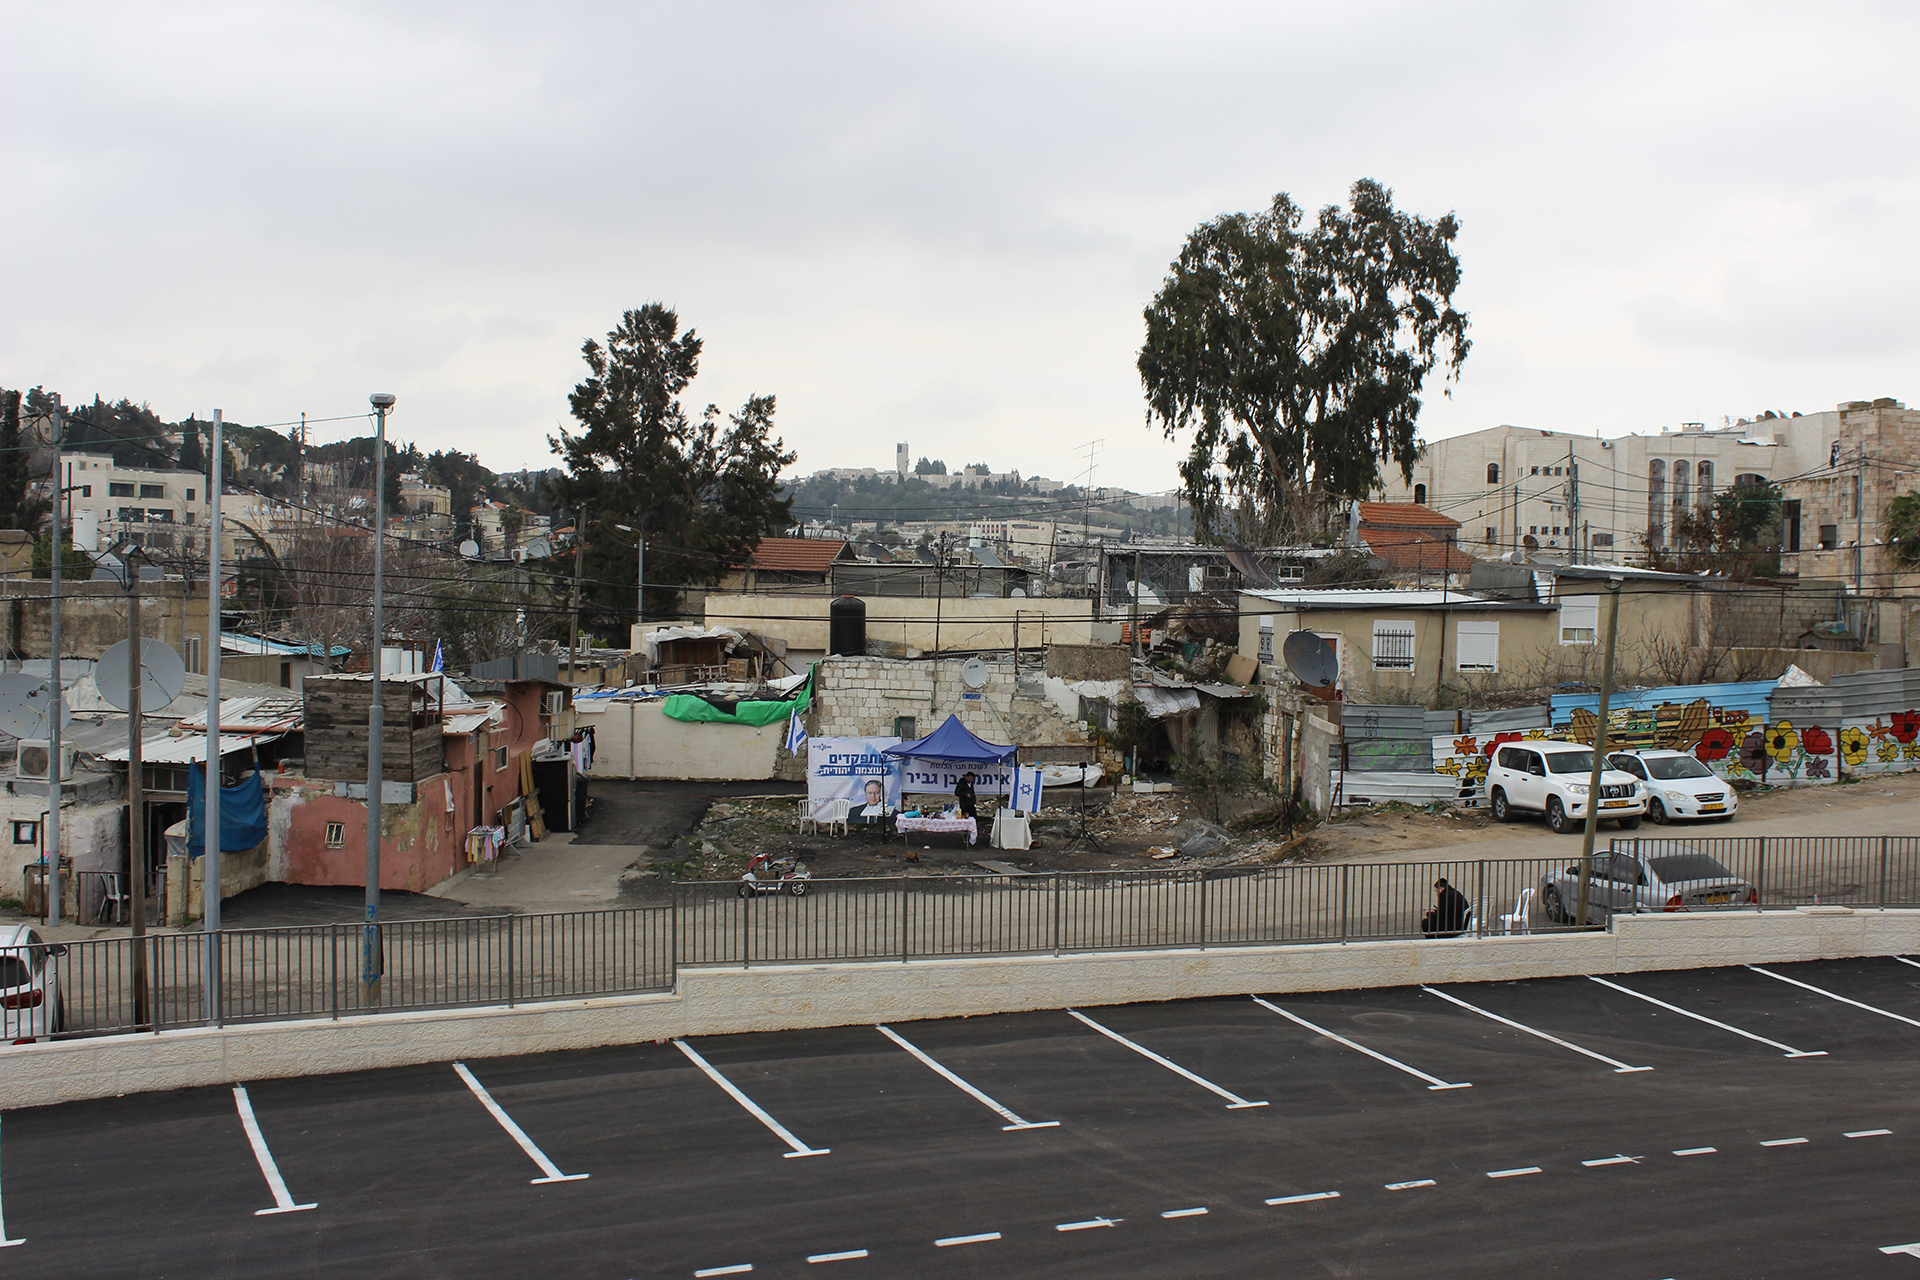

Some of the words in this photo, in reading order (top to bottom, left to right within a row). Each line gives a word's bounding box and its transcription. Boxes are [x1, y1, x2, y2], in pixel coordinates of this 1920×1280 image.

[854, 766, 888, 775] לעוצמה
[907, 772, 938, 784] גביר
[962, 773, 1010, 785] איתמ
